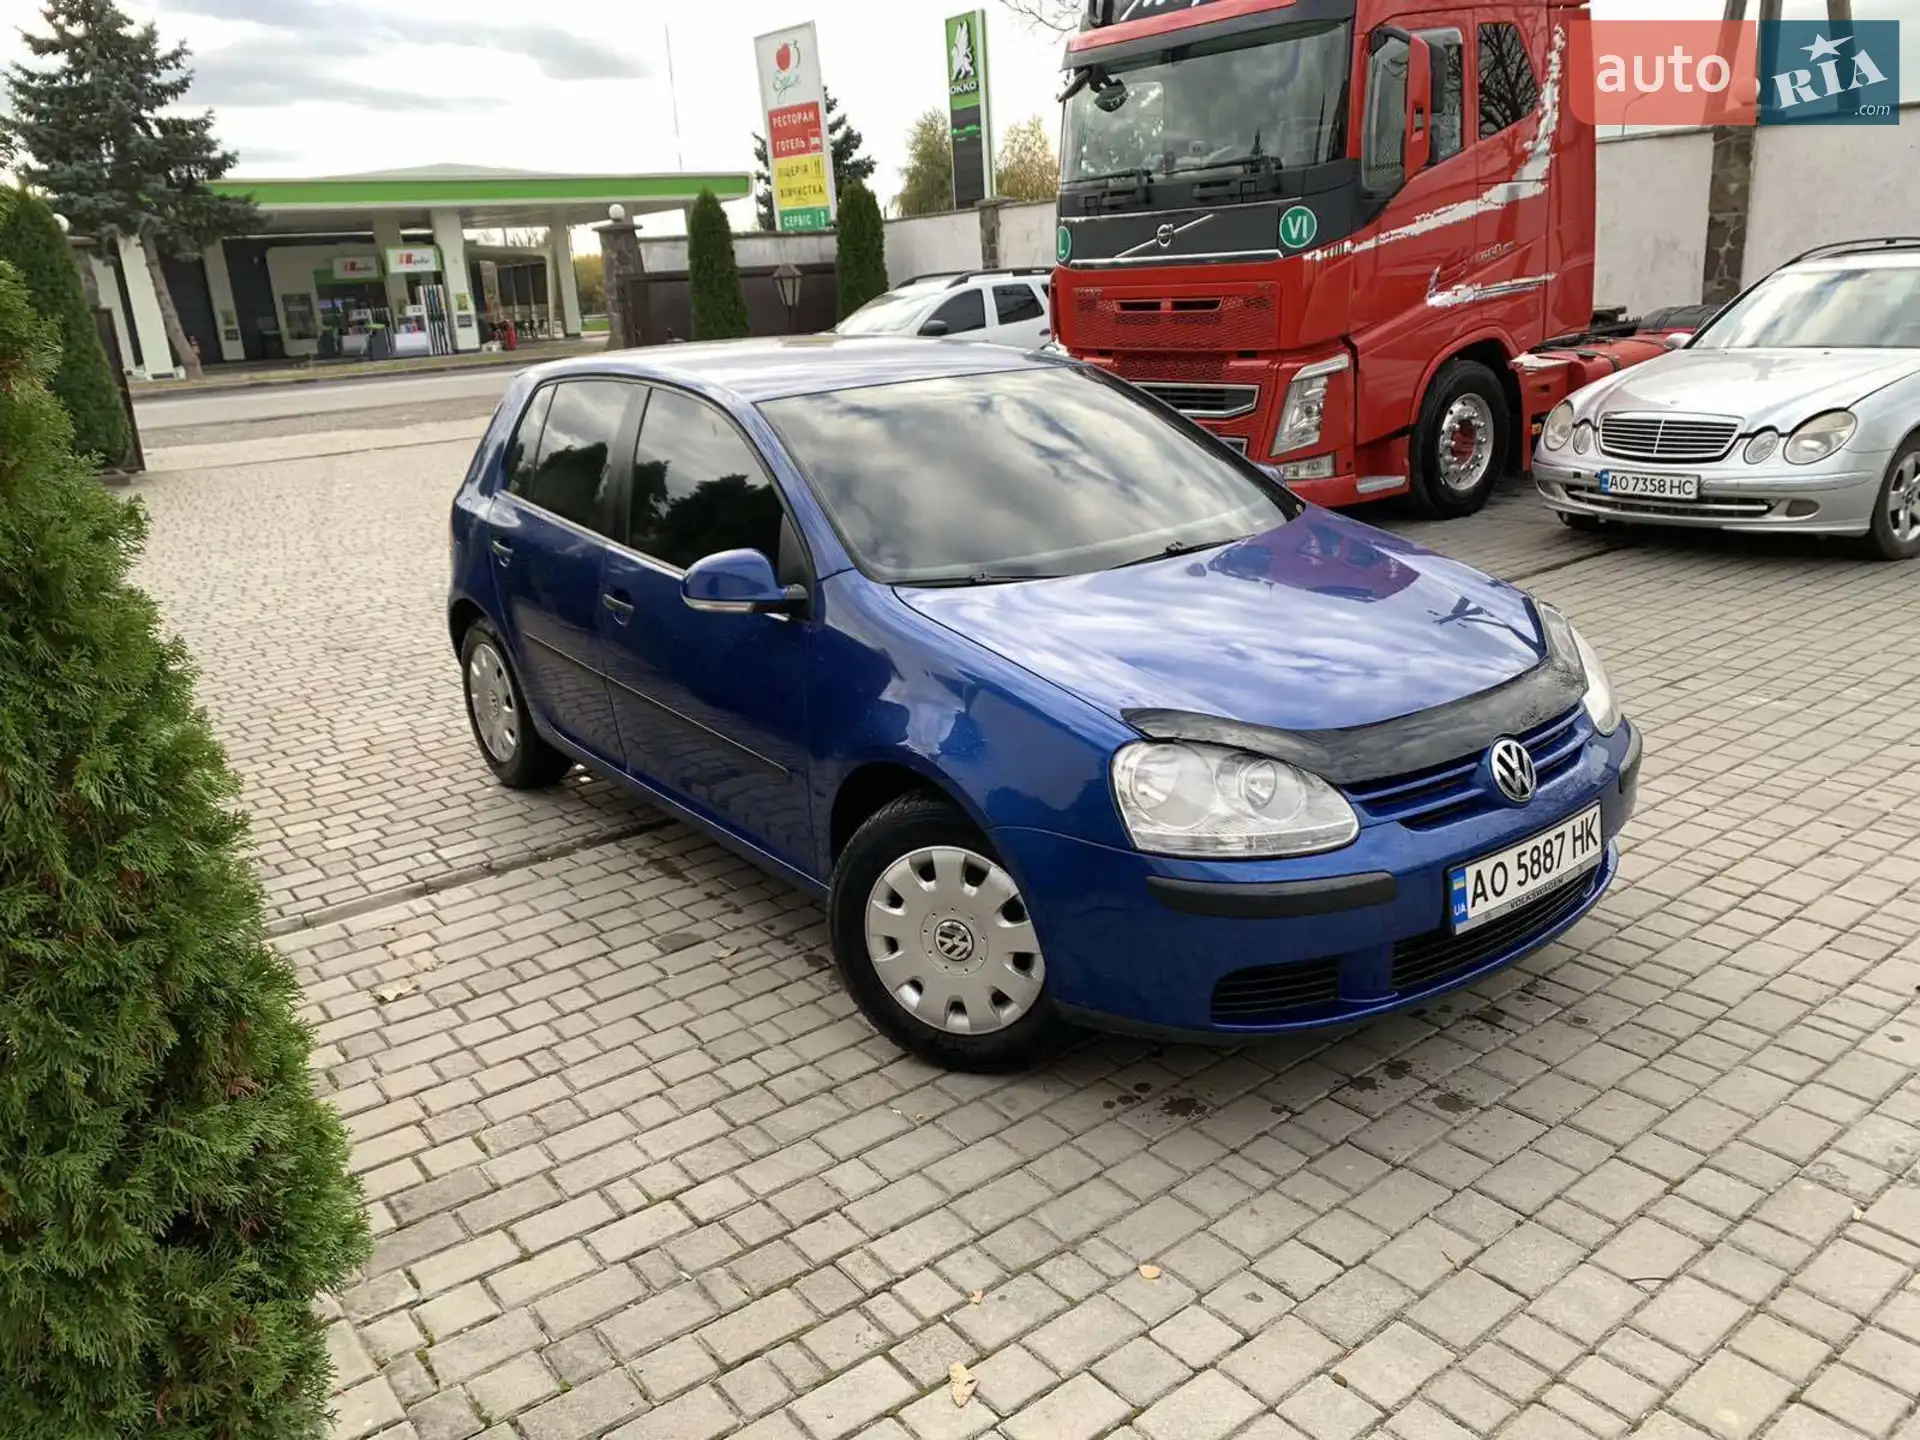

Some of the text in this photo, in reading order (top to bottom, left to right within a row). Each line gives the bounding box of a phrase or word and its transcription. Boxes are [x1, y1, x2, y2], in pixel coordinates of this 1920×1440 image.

[950, 81, 976, 95] OKKO
[772, 110, 816, 129] РЕСТОРАН
[776, 137, 806, 152] ГОТЕЛЬ
[1287, 215, 1308, 239] VI
[1609, 475, 1694, 495] AO 7358 HC
[1470, 812, 1599, 909] AO 5887 HK
[1510, 877, 1564, 909] VOLKSWAGEN
[1453, 904, 1466, 916] UA
